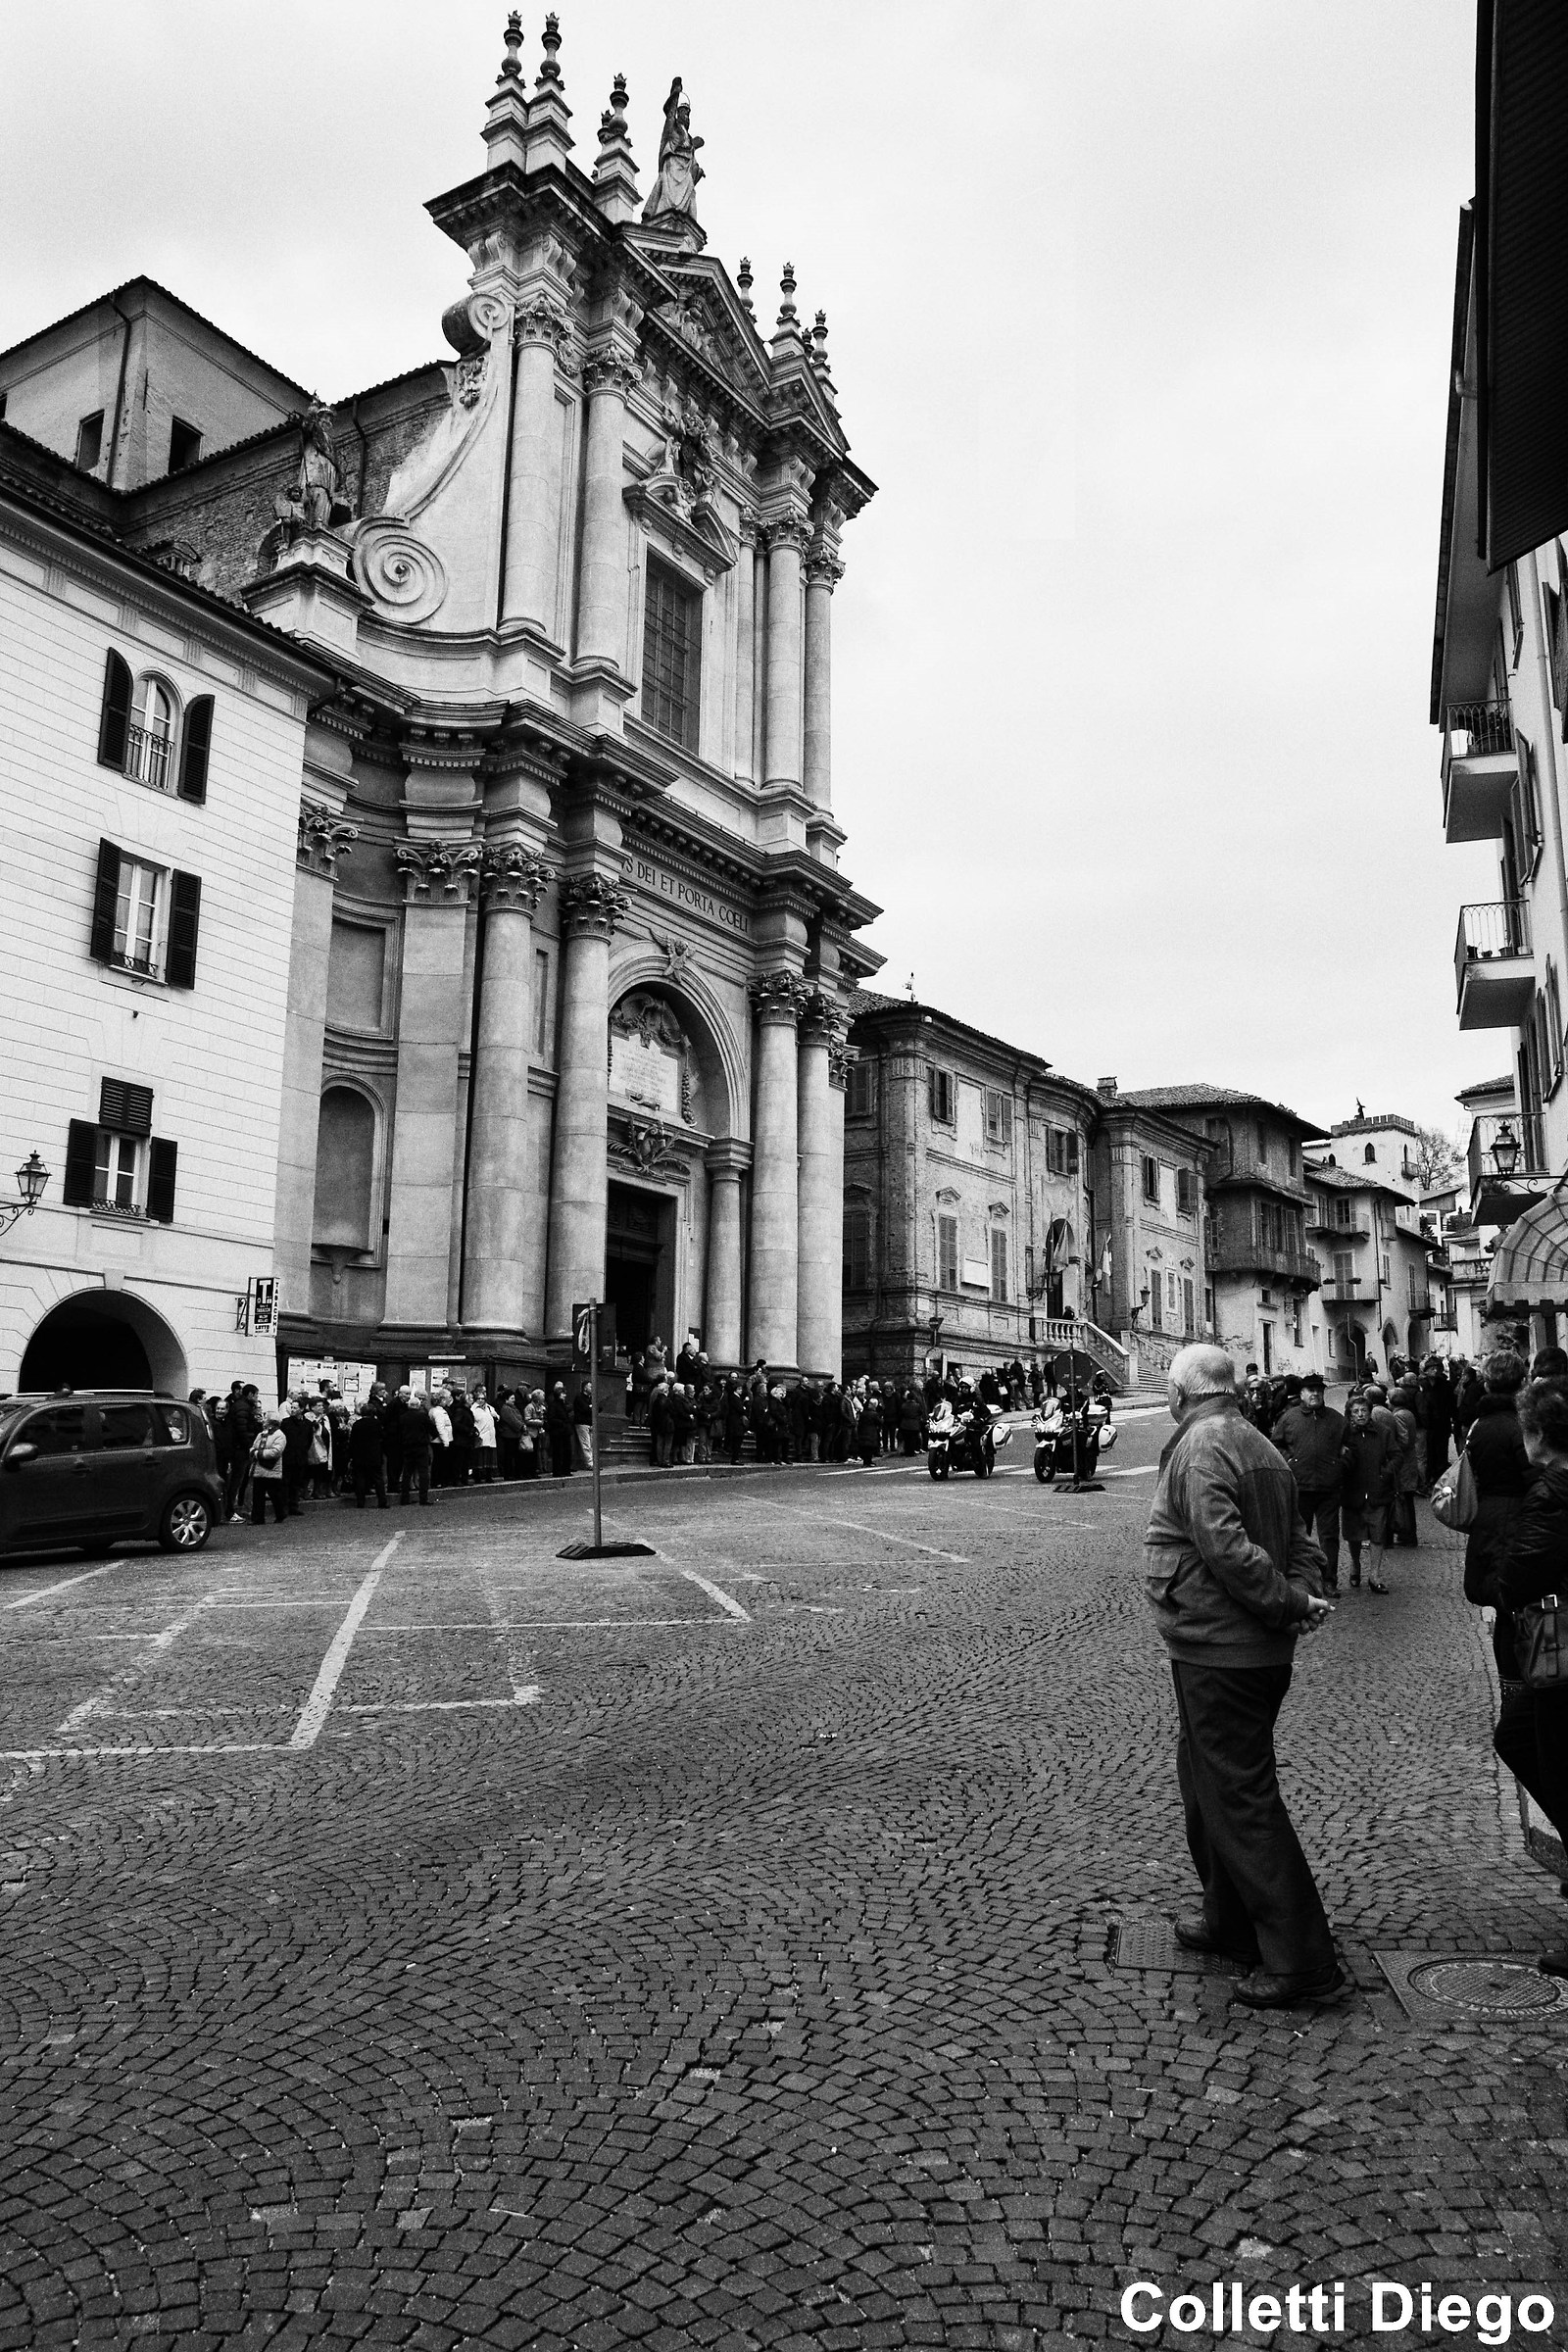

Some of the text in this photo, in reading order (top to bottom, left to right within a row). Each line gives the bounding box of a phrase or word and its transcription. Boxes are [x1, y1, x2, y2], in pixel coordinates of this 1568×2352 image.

[637, 860, 656, 886] DEI
[661, 873, 675, 895] ET
[678, 883, 714, 916] PORTA
[718, 906, 748, 932] COELI
[259, 1280, 271, 1303] T
